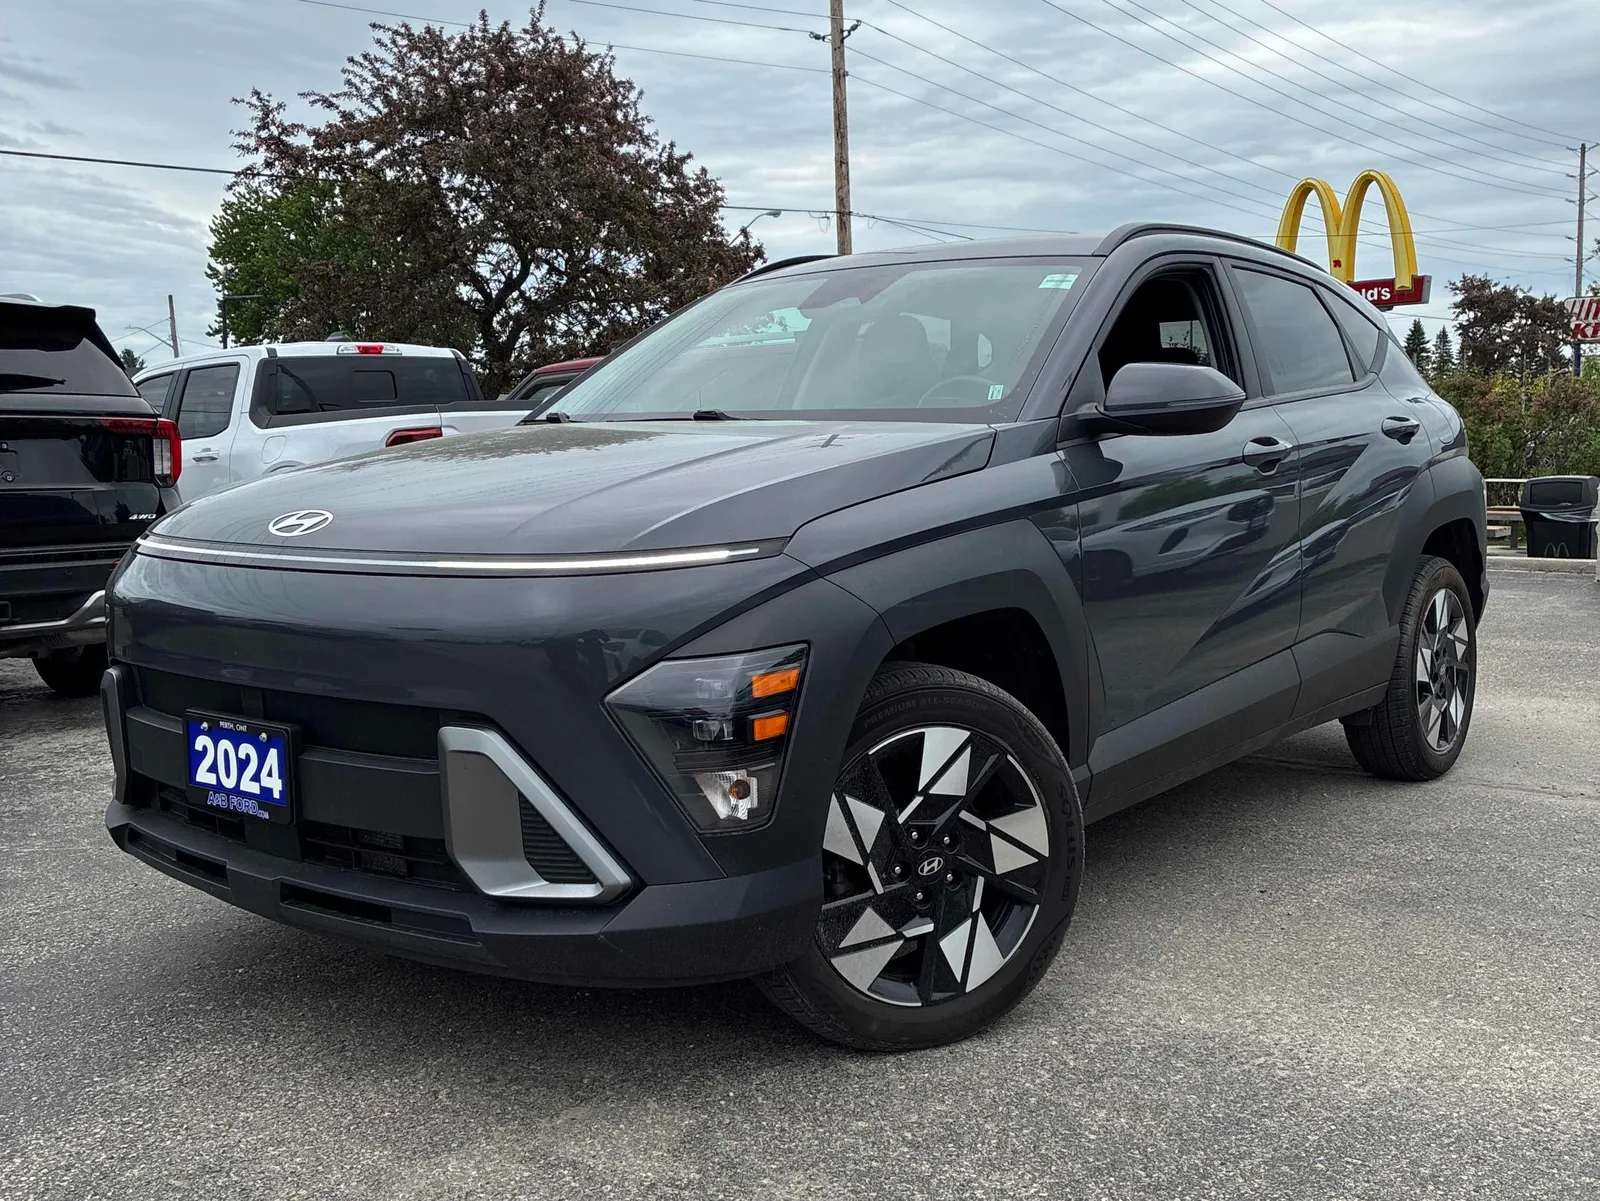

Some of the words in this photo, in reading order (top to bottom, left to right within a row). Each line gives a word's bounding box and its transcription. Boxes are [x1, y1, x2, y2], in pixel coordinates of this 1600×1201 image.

[863, 699, 916, 728] PREMIUM
[919, 696, 988, 712] ALL-SEASON
[194, 735, 283, 799] 2024
